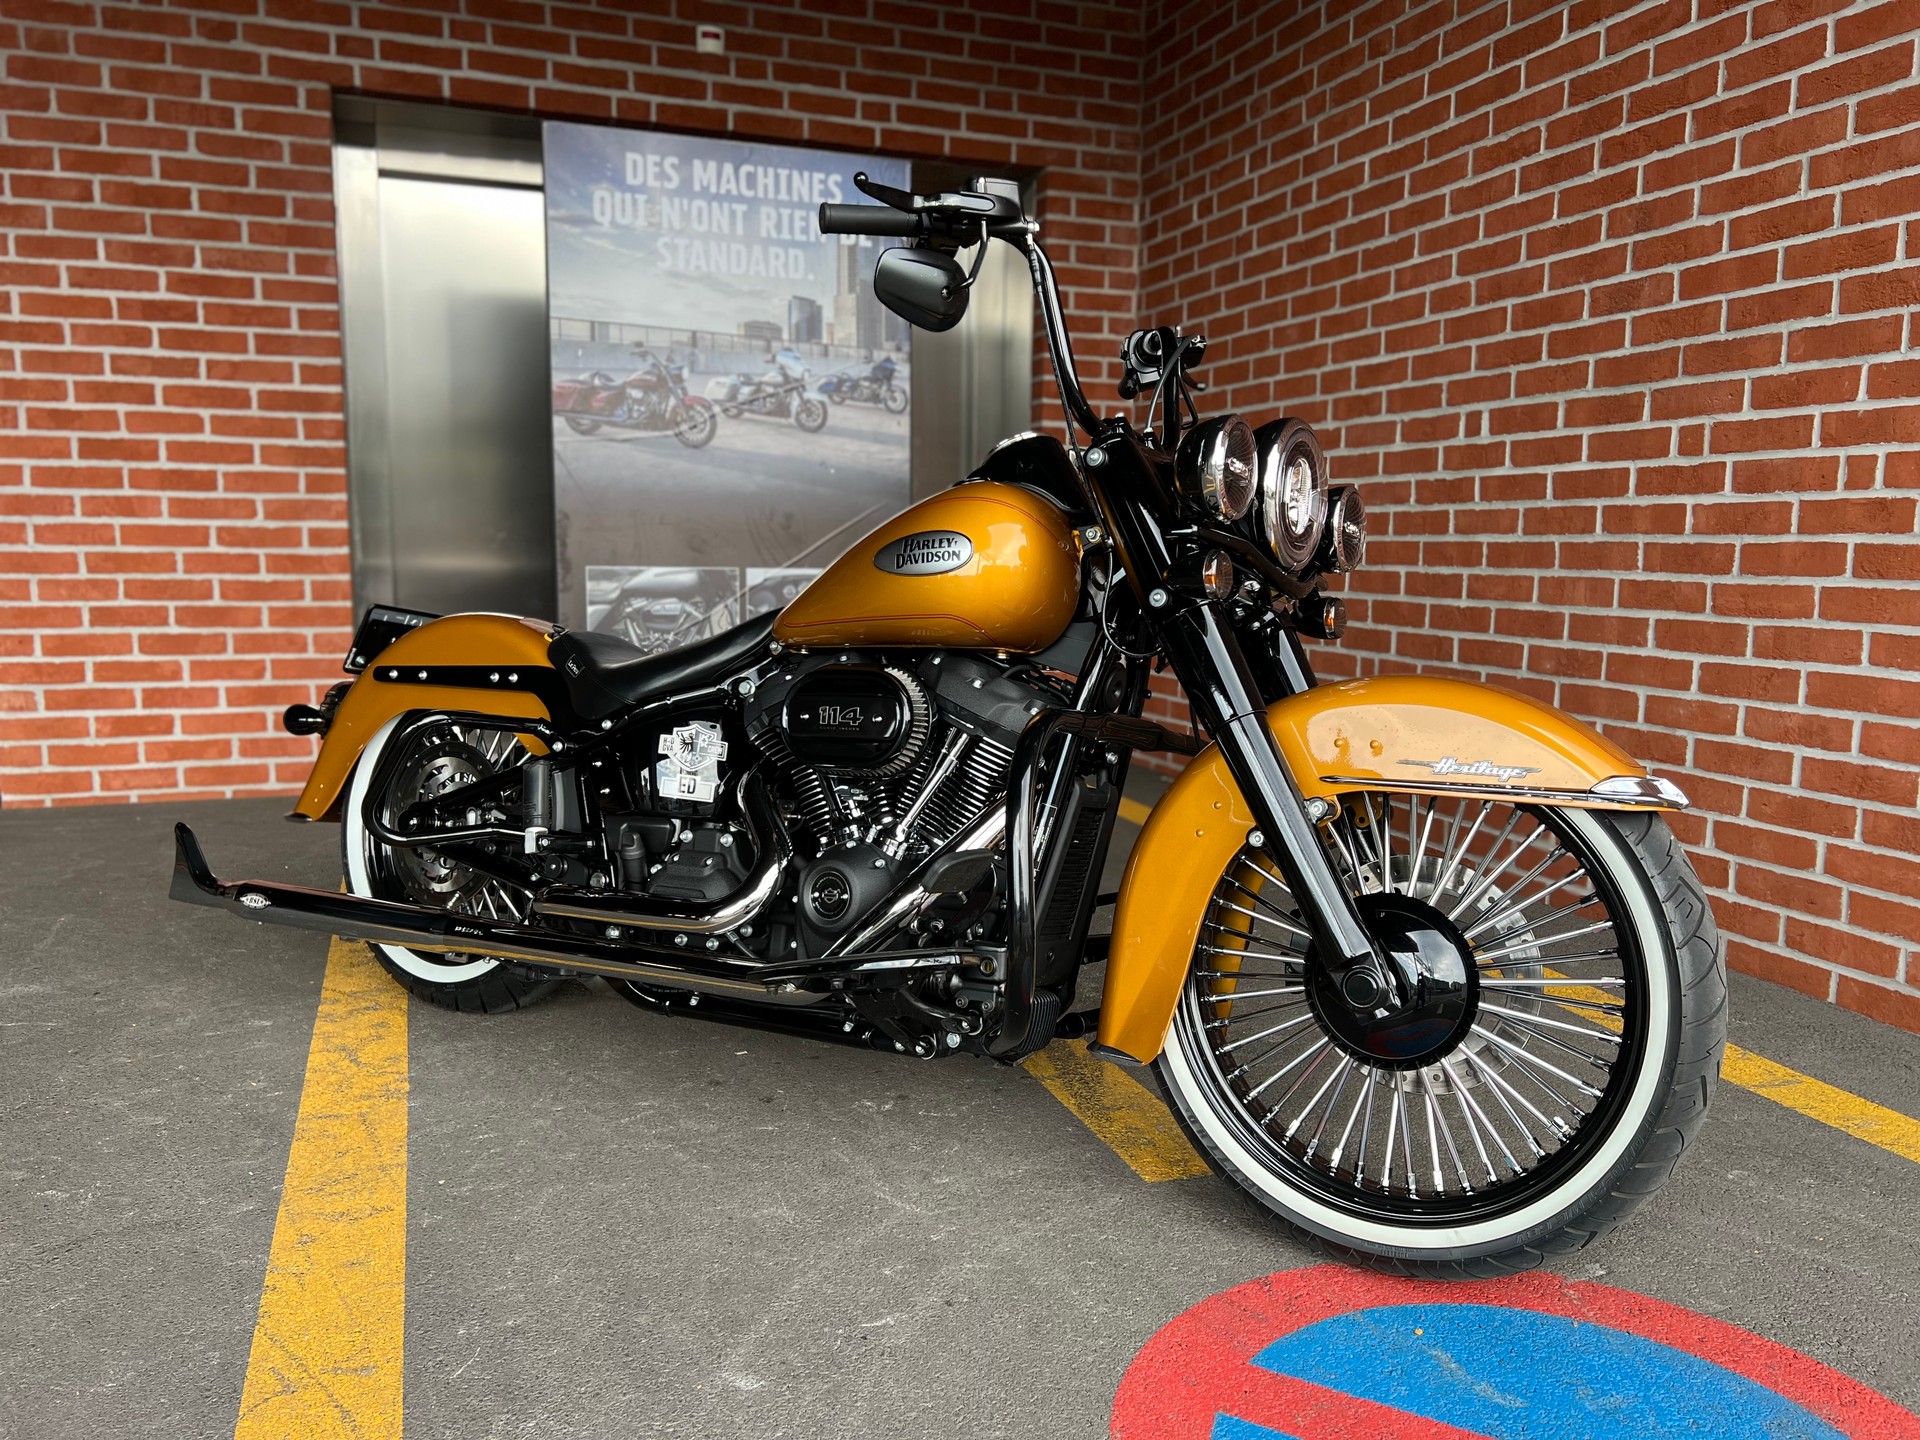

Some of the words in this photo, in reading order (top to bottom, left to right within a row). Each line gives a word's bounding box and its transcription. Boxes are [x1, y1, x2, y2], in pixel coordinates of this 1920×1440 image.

[624, 151, 680, 190] DES
[692, 158, 843, 205] MACHINES
[592, 189, 648, 229] QUI
[661, 196, 748, 237] N'ONT
[656, 236, 815, 281] STANDARD.
[895, 549, 961, 569] DAVIDSON
[819, 706, 864, 725] 114
[1432, 756, 1528, 782] Heritage
